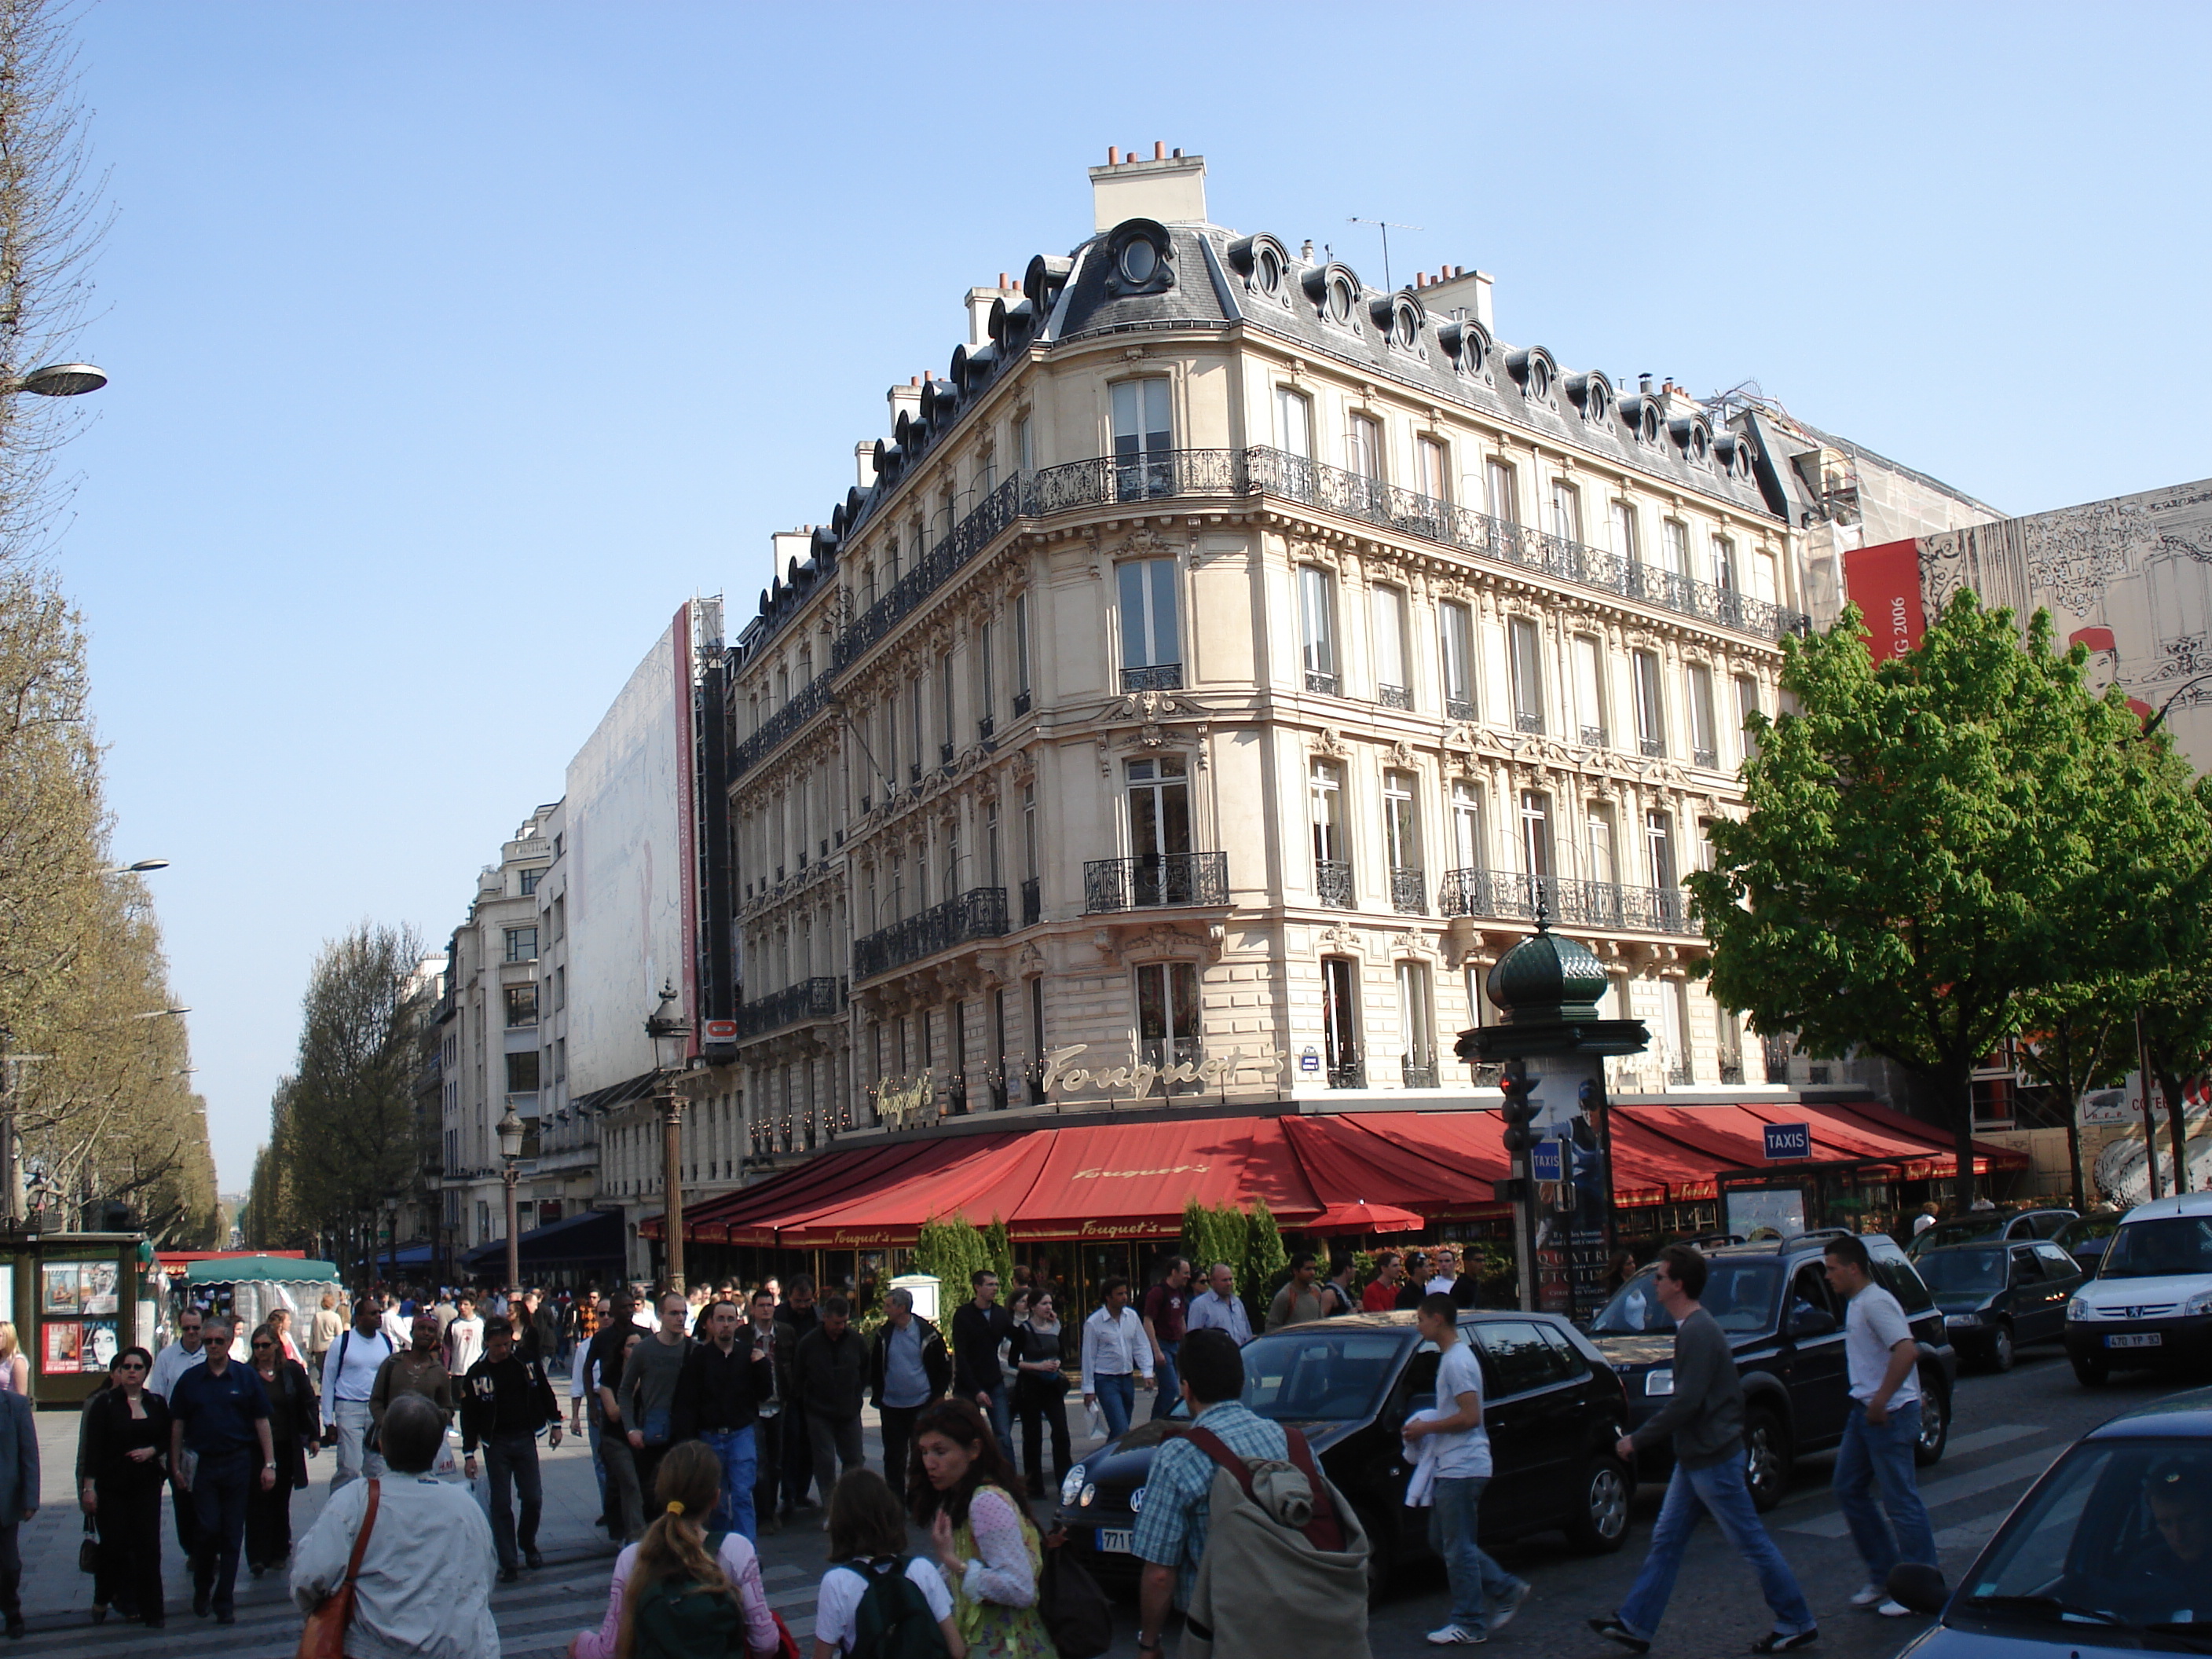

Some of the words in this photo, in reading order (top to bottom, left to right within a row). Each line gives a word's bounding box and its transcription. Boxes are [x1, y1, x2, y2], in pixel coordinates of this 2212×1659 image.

[1890, 597, 1908, 635] 2006
[1043, 1041, 1287, 1101] Fouquet's
[1767, 1133, 1804, 1149] TAXIS
[1534, 1155, 1560, 1167] TAXIS
[1072, 1165, 1210, 1181] Fouquet's
[1081, 1220, 1158, 1238] Fouquet's
[834, 1229, 890, 1247] Fouquet's
[1104, 1532, 1126, 1548] 771
